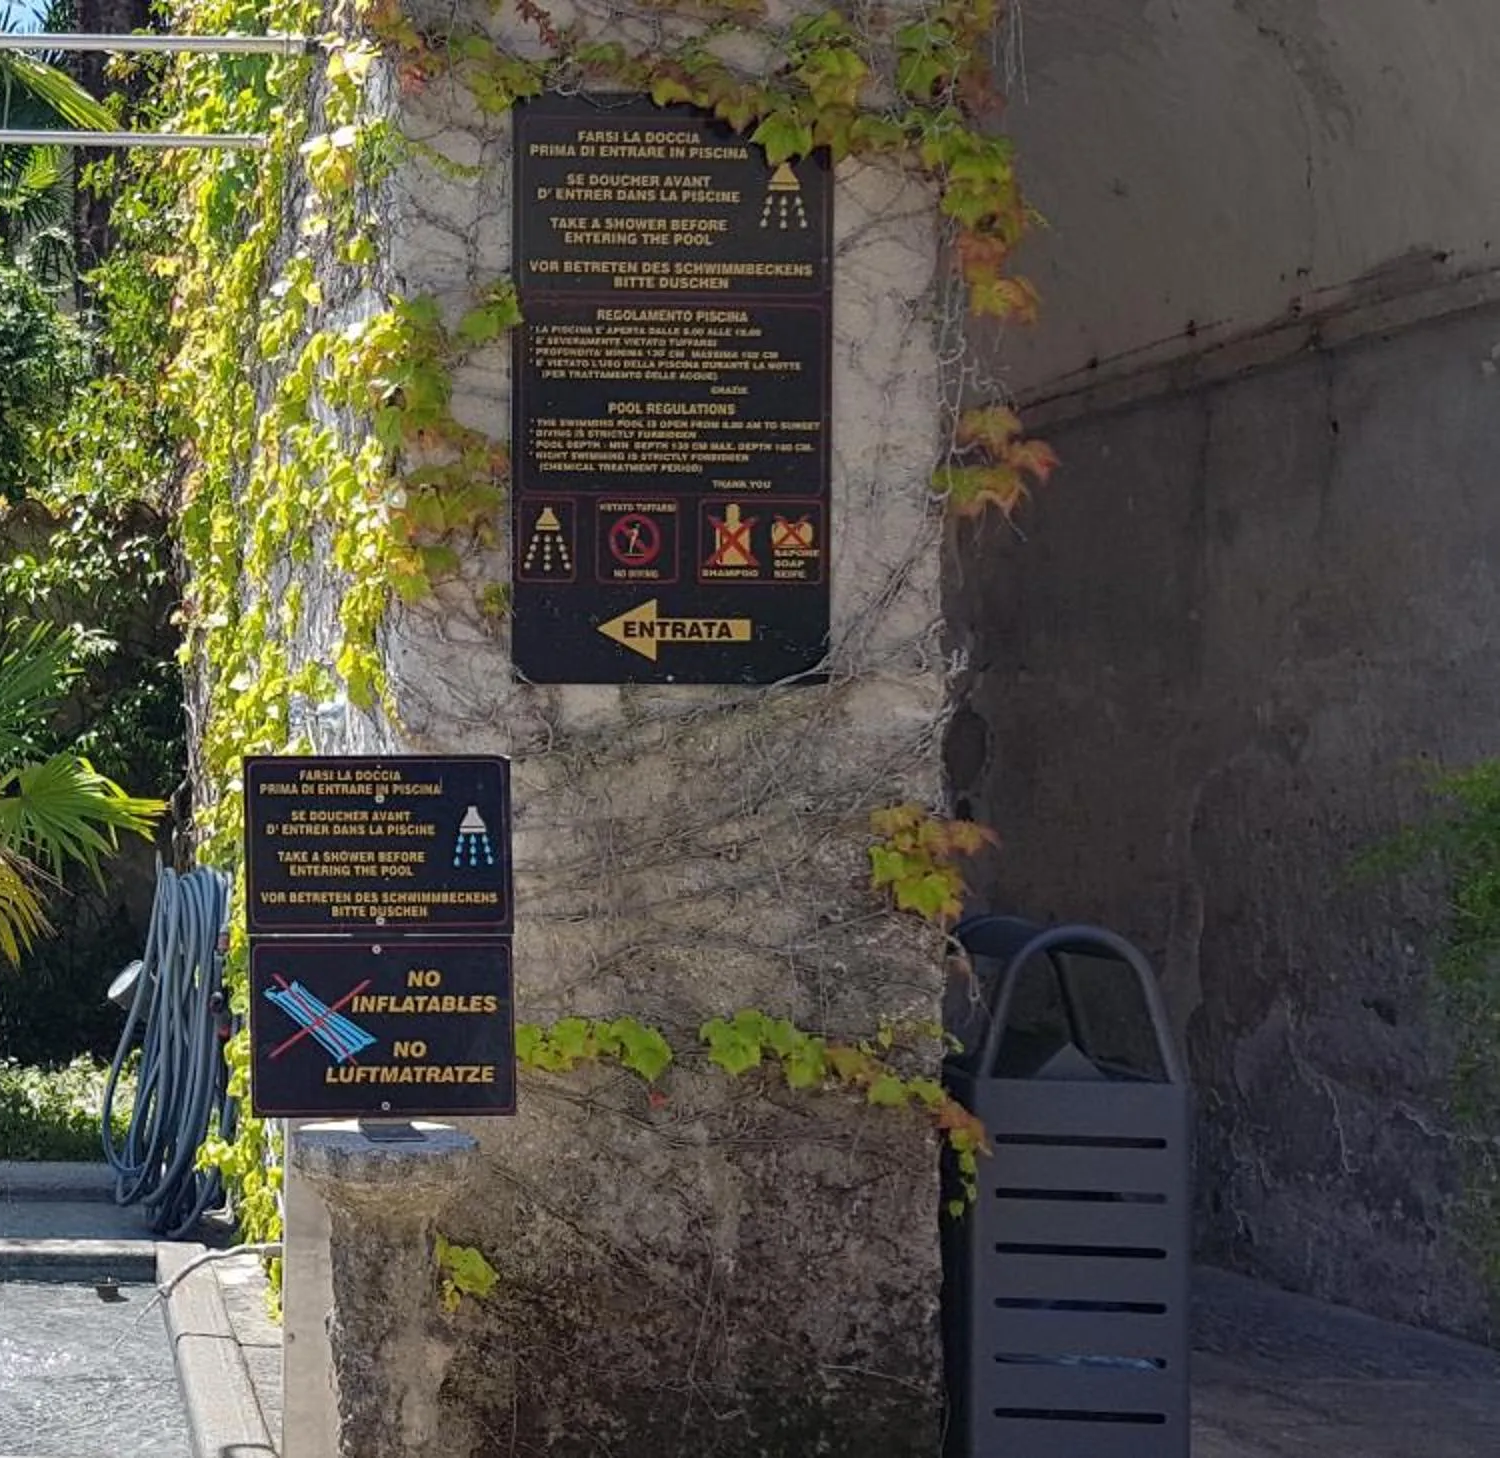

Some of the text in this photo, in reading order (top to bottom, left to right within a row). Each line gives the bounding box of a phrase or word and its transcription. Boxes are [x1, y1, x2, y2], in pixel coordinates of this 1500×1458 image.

[578, 131, 700, 143] FARSI LA DOCCIA
[530, 144, 748, 159] PRIMA DI ENTRARE IN PISCINA
[567, 174, 712, 187] SE DOUCHER AVANT
[538, 188, 740, 203] D' ENTRER DANS LA PISCINE
[551, 218, 728, 231] TAKE A SHOWER BEFORE
[564, 233, 713, 246] ENTERING THE POOL
[529, 260, 812, 276] VOR BETRETEN DES SCHWIMMBECKENS
[614, 276, 728, 289] BITTE DUSCHEN
[597, 309, 748, 323] REGOLAMENTO PISCINA
[535, 325, 548, 334] LA
[551, 326, 593, 335] PISCINA
[605, 327, 646, 335] APERTA
[707, 328, 733, 336] ALLE
[547, 337, 621, 346] SEVERAMENTE
[624, 338, 667, 346] VIETATO
[669, 338, 717, 347] TUFFARSI
[691, 351, 739, 359] MASSIMA
[547, 359, 589, 368] VIETATO
[623, 360, 655, 368] DELLA
[657, 361, 699, 370] PISCINA
[702, 361, 749, 370] DURANTE
[752, 362, 765, 370] LA
[768, 362, 801, 371] NOTTE
[569, 371, 642, 379] TRATTAMENTO
[710, 385, 749, 395] GRAZIE
[608, 402, 736, 416] POOL REGULATIONS
[537, 419, 557, 427] THE
[559, 419, 614, 428] SWIMMING
[617, 420, 644, 428] POOL
[647, 420, 657, 428] IS
[659, 420, 689, 429] OPEN
[691, 421, 720, 429] FROM
[746, 421, 762, 430] AM
[764, 422, 777, 430] TO
[780, 422, 820, 431] SUNSET
[536, 429, 697, 439] DIVING IS STRICTLY FORBIDDEN
[536, 440, 564, 449] POOL
[566, 441, 601, 449] DEPTH
[633, 441, 669, 450] DEPTH
[738, 443, 772, 451] DEPTH
[536, 451, 749, 461] NIGHT SWIMMING IS STRICTLY FORBIDDEN
[598, 463, 658, 472] TREATMENT
[711, 479, 772, 489] THANK YOU
[773, 549, 820, 558] SAPONE
[774, 559, 804, 568] SOAP
[613, 569, 626, 578] NO
[702, 569, 759, 578] SHAMPOO
[623, 621, 732, 639] ENTRATA
[300, 770, 401, 781] FARSI LA DOCCIA
[260, 784, 440, 795] PRIMA DI ENTRARE IN PISCINA
[291, 811, 412, 822] SE DOUCHER AVANT
[266, 824, 435, 835] D' ENTRER DANS LA PISCINE
[278, 851, 425, 863] TAKE A SHOWER BEFORE
[289, 865, 413, 877] ENTERING THE POOL
[260, 892, 498, 904] VOR BETRETEN DES SCHWIMMBECKENS
[331, 905, 428, 917] BITTE DUSCHEN
[407, 970, 441, 988] NO
[351, 996, 498, 1013] INFLATABLES
[393, 1041, 427, 1058] NO
[325, 1065, 495, 1083] LUFTMATRATZE
